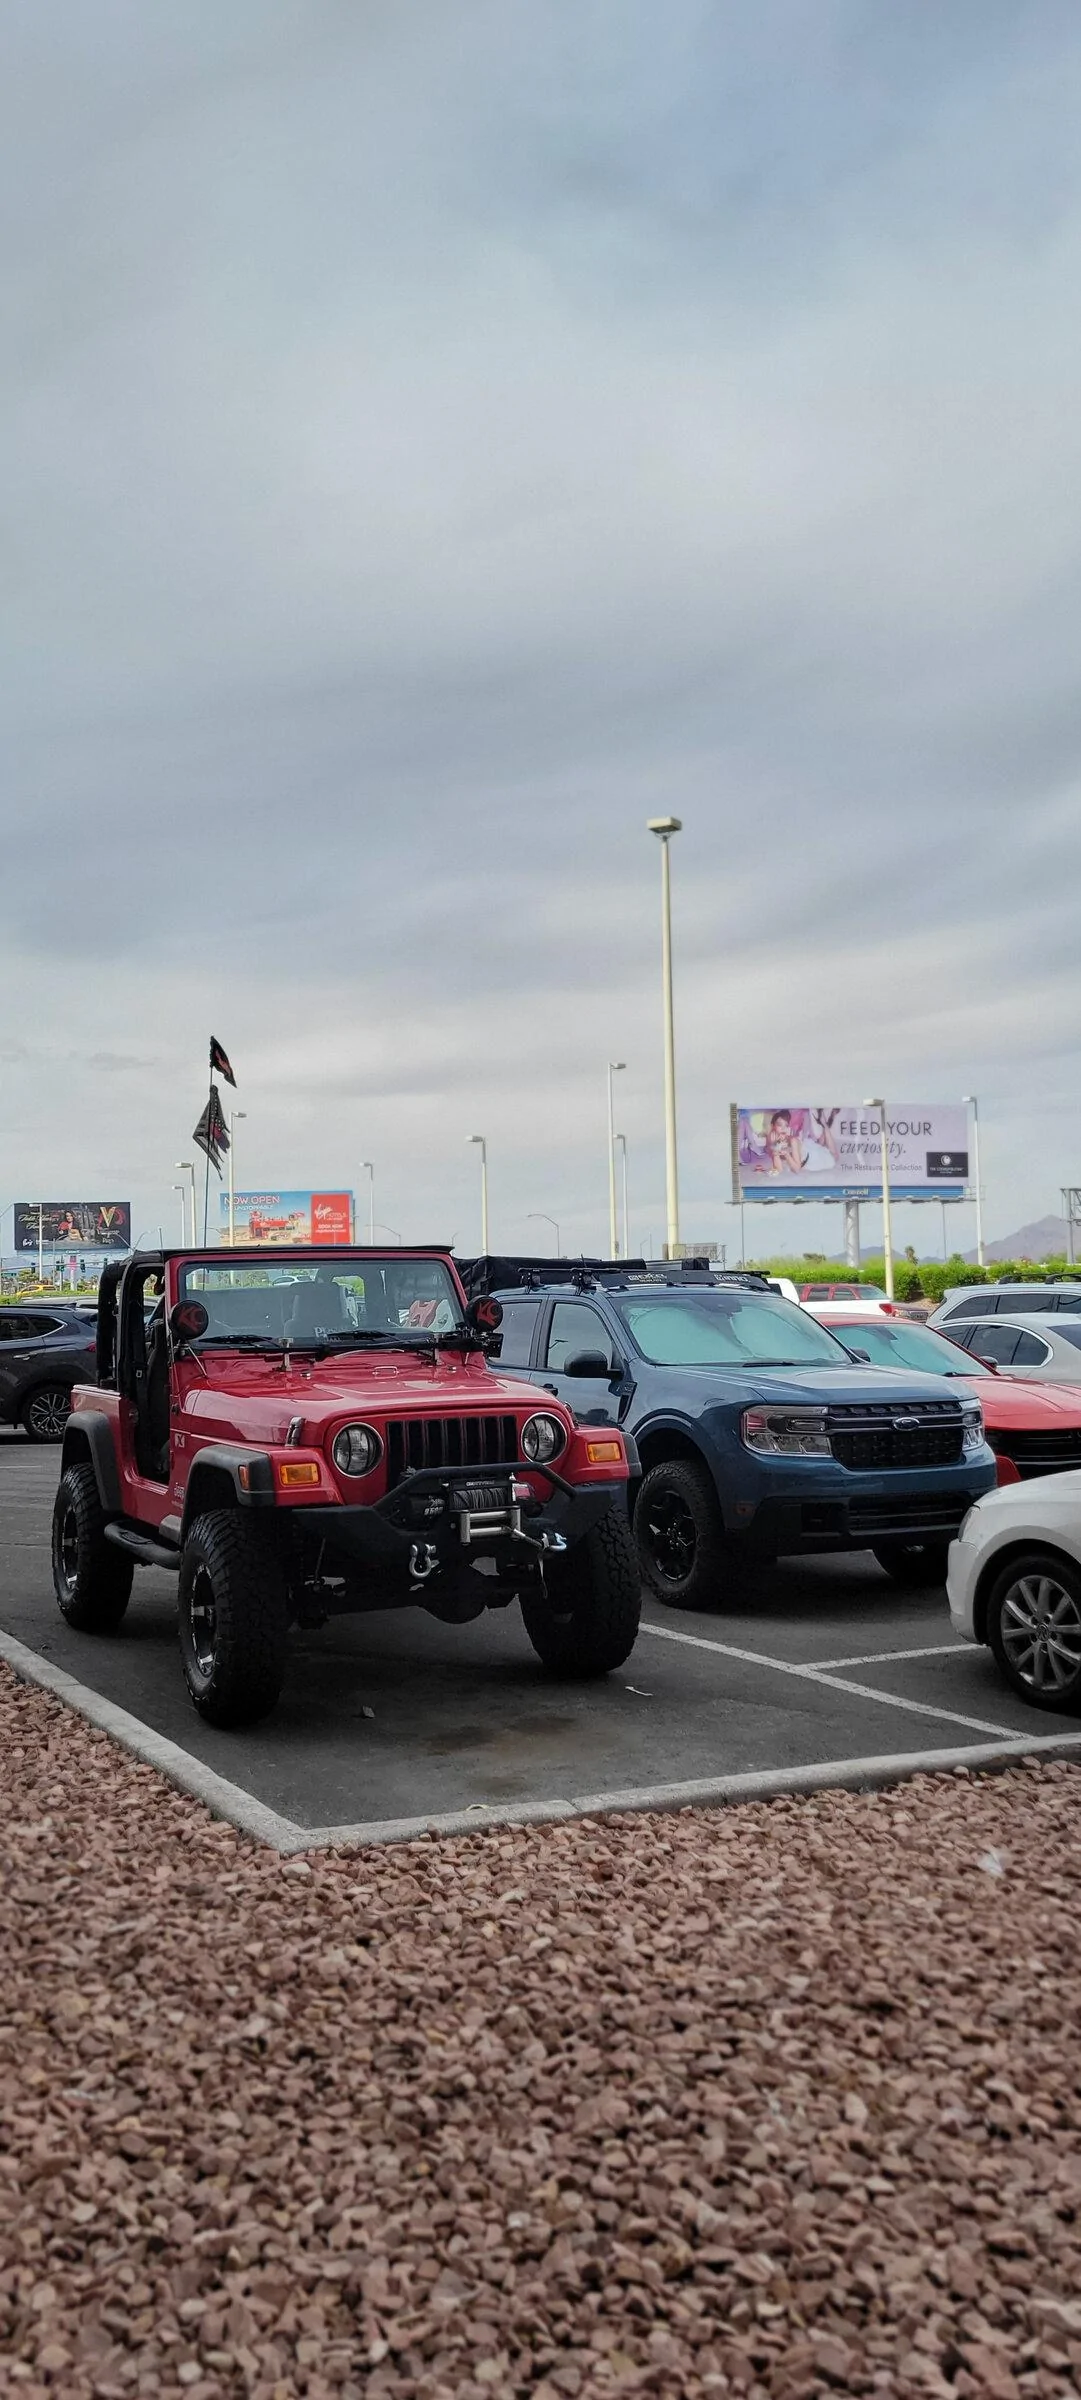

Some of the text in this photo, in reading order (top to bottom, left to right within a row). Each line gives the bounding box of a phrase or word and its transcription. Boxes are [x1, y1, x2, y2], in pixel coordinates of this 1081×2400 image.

[840, 1121, 932, 1136] FEED YOUR
[840, 1164, 922, 1172] The Restaurat Collection
[250, 1195, 281, 1204] OPEN
[100, 1206, 117, 1228] V
